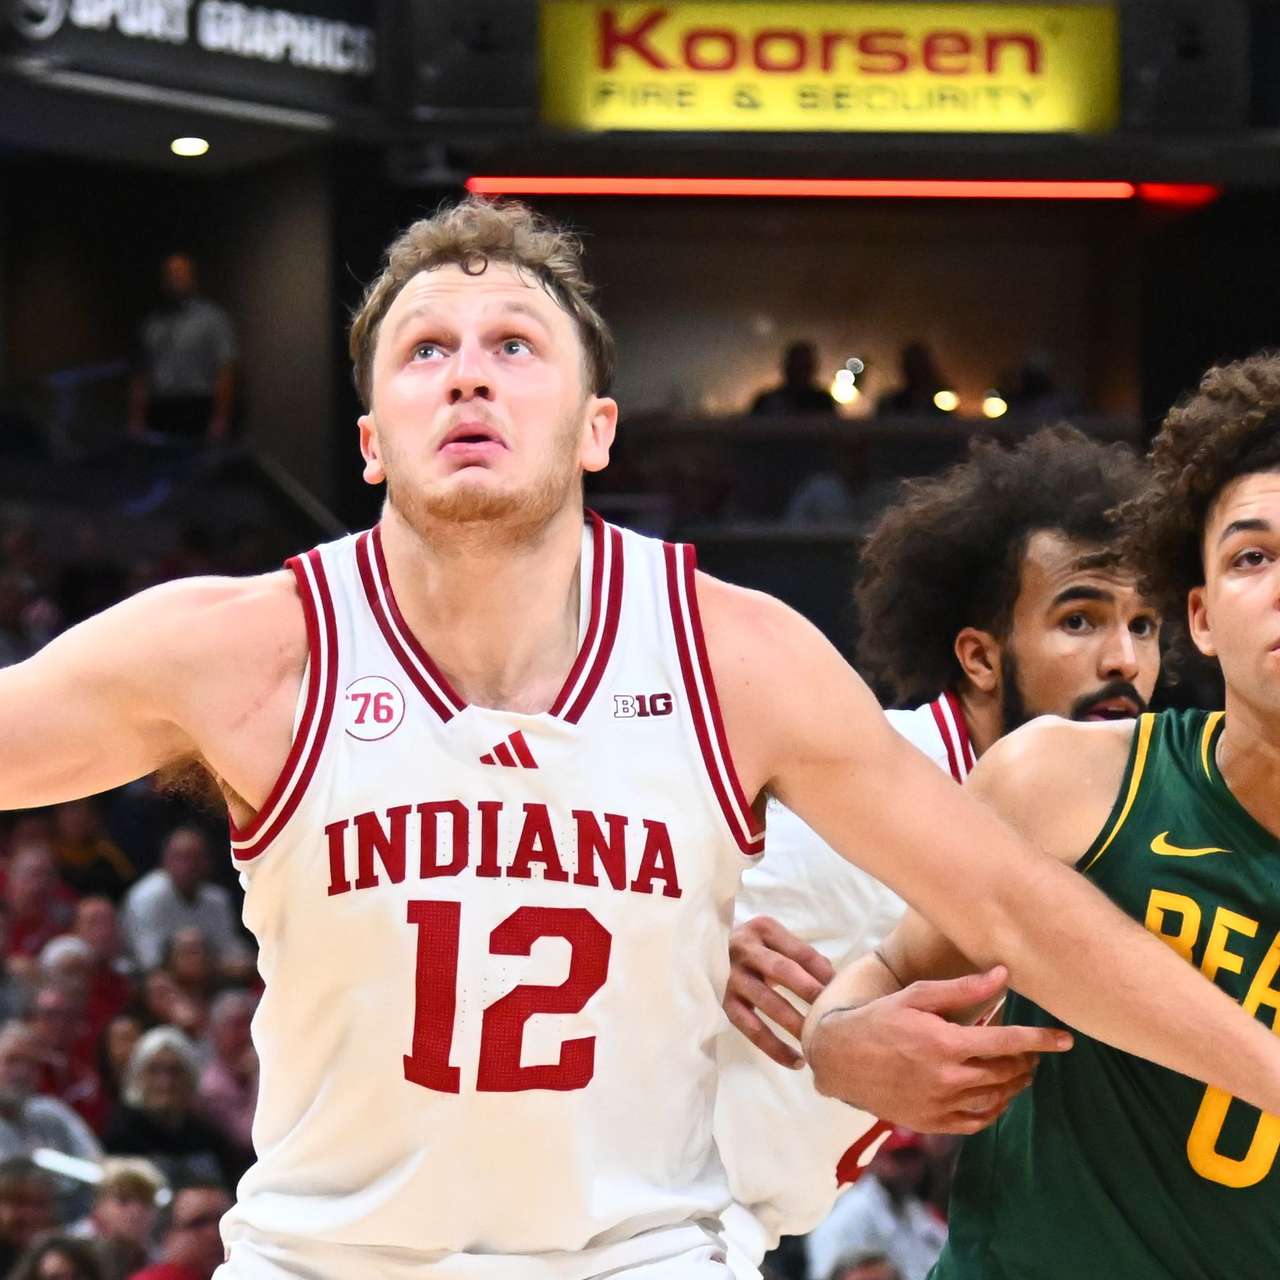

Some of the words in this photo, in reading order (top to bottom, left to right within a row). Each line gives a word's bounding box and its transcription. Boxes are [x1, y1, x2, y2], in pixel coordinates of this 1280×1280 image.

[597, 7, 1043, 76] Koorsen
[595, 82, 696, 110] FIRE
[732, 83, 762, 110] &
[797, 83, 1046, 111] SECURITY
[324, 799, 682, 898] INDIANA
[403, 900, 612, 1094] 12
